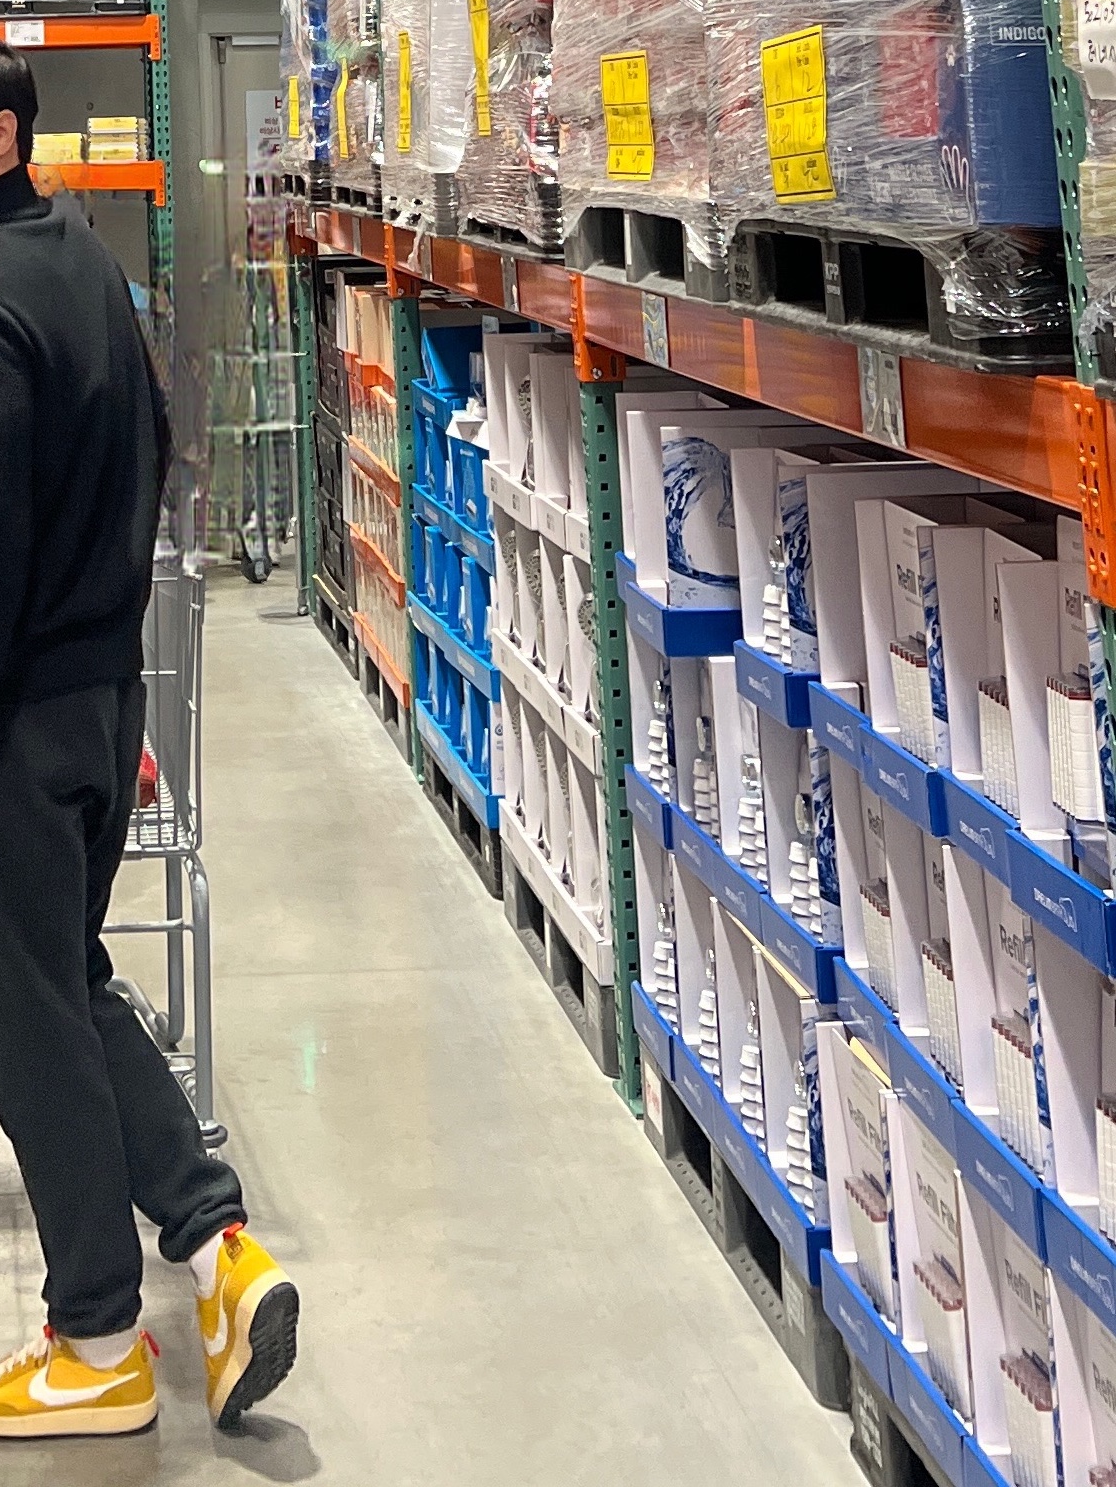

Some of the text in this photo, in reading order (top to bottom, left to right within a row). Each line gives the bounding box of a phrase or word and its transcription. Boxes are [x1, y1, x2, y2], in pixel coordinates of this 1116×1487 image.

[999, 26, 1046, 41] INDIGO
[824, 261, 840, 281] KPP
[1004, 1258, 1035, 1312] Refill
